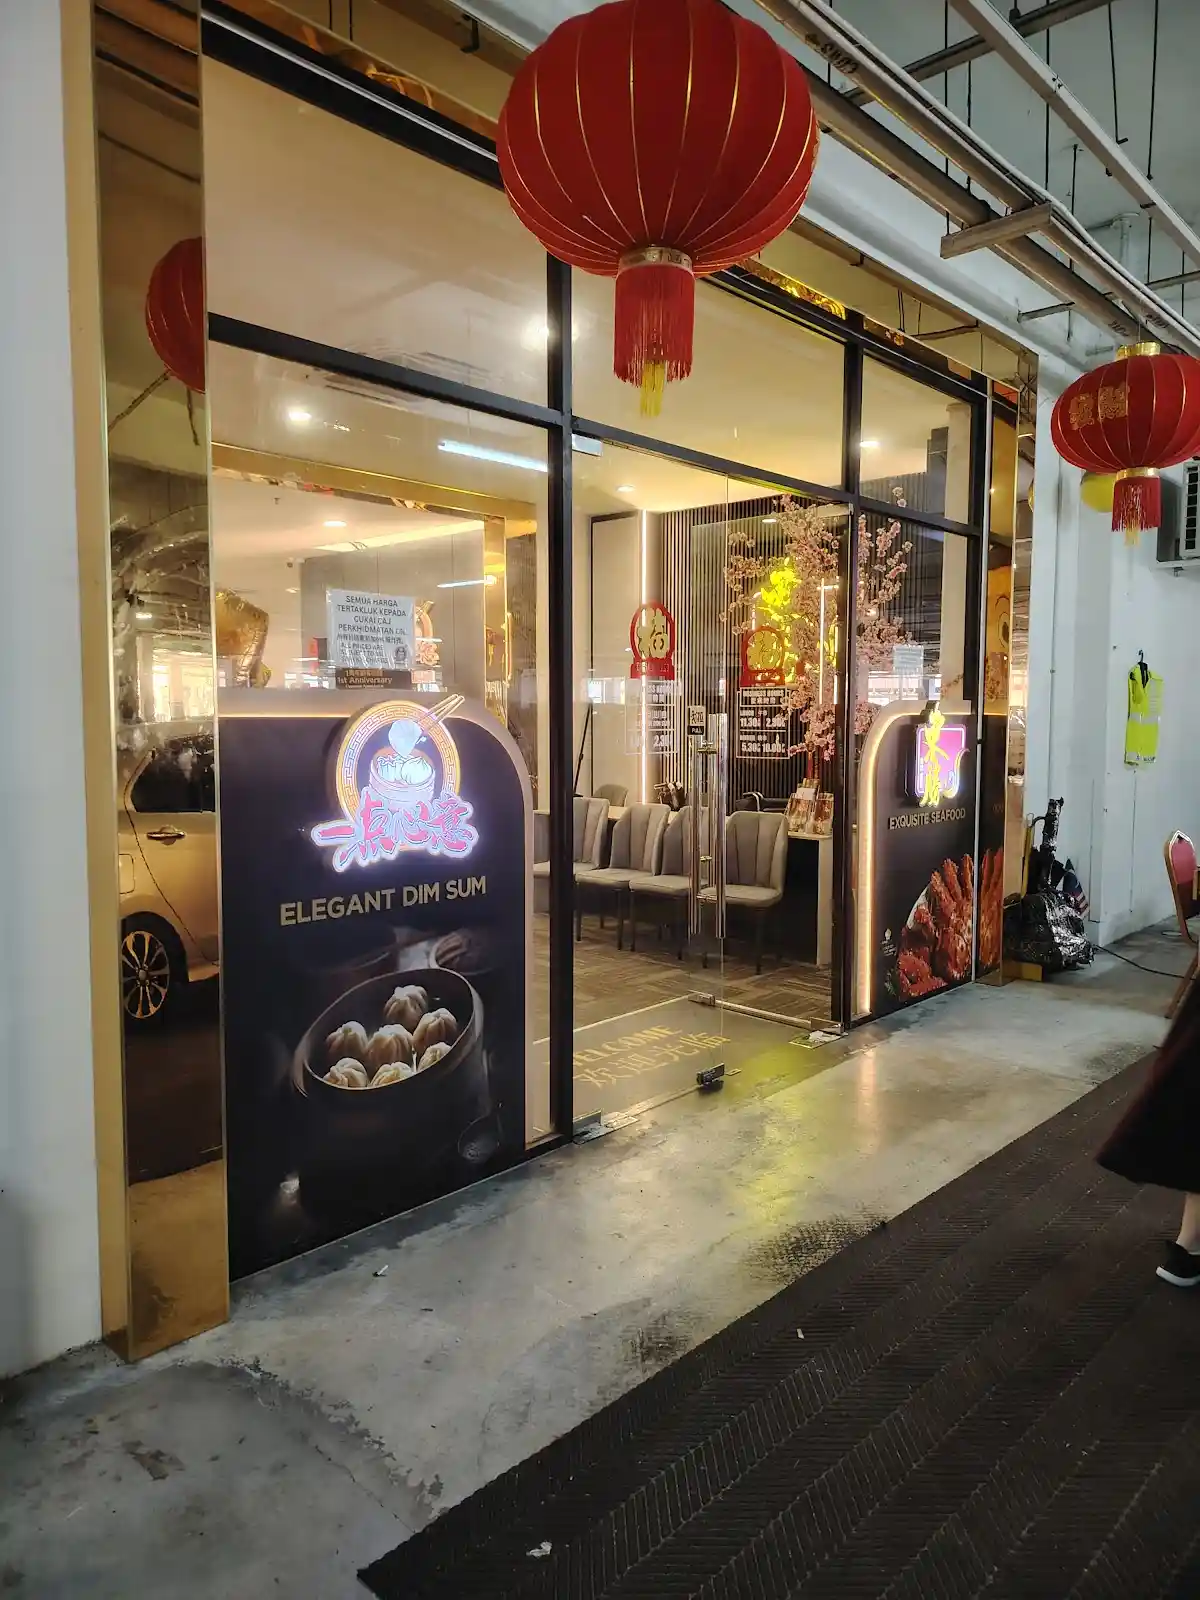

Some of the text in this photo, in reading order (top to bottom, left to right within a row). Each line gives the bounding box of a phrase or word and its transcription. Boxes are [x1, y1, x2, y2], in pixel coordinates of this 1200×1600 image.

[345, 595, 398, 607] SEMUA HARGA
[337, 604, 407, 617] TERTAKLUK KEPADA
[353, 615, 376, 623] CUKAI
[338, 623, 394, 635] PERKHIDMATAN
[349, 677, 393, 685] Anniversary
[889, 807, 966, 830] EXQUISITE SEAFOOD
[313, 791, 477, 870] 一点心意
[280, 875, 486, 926] ELEGANT DIM SUM
